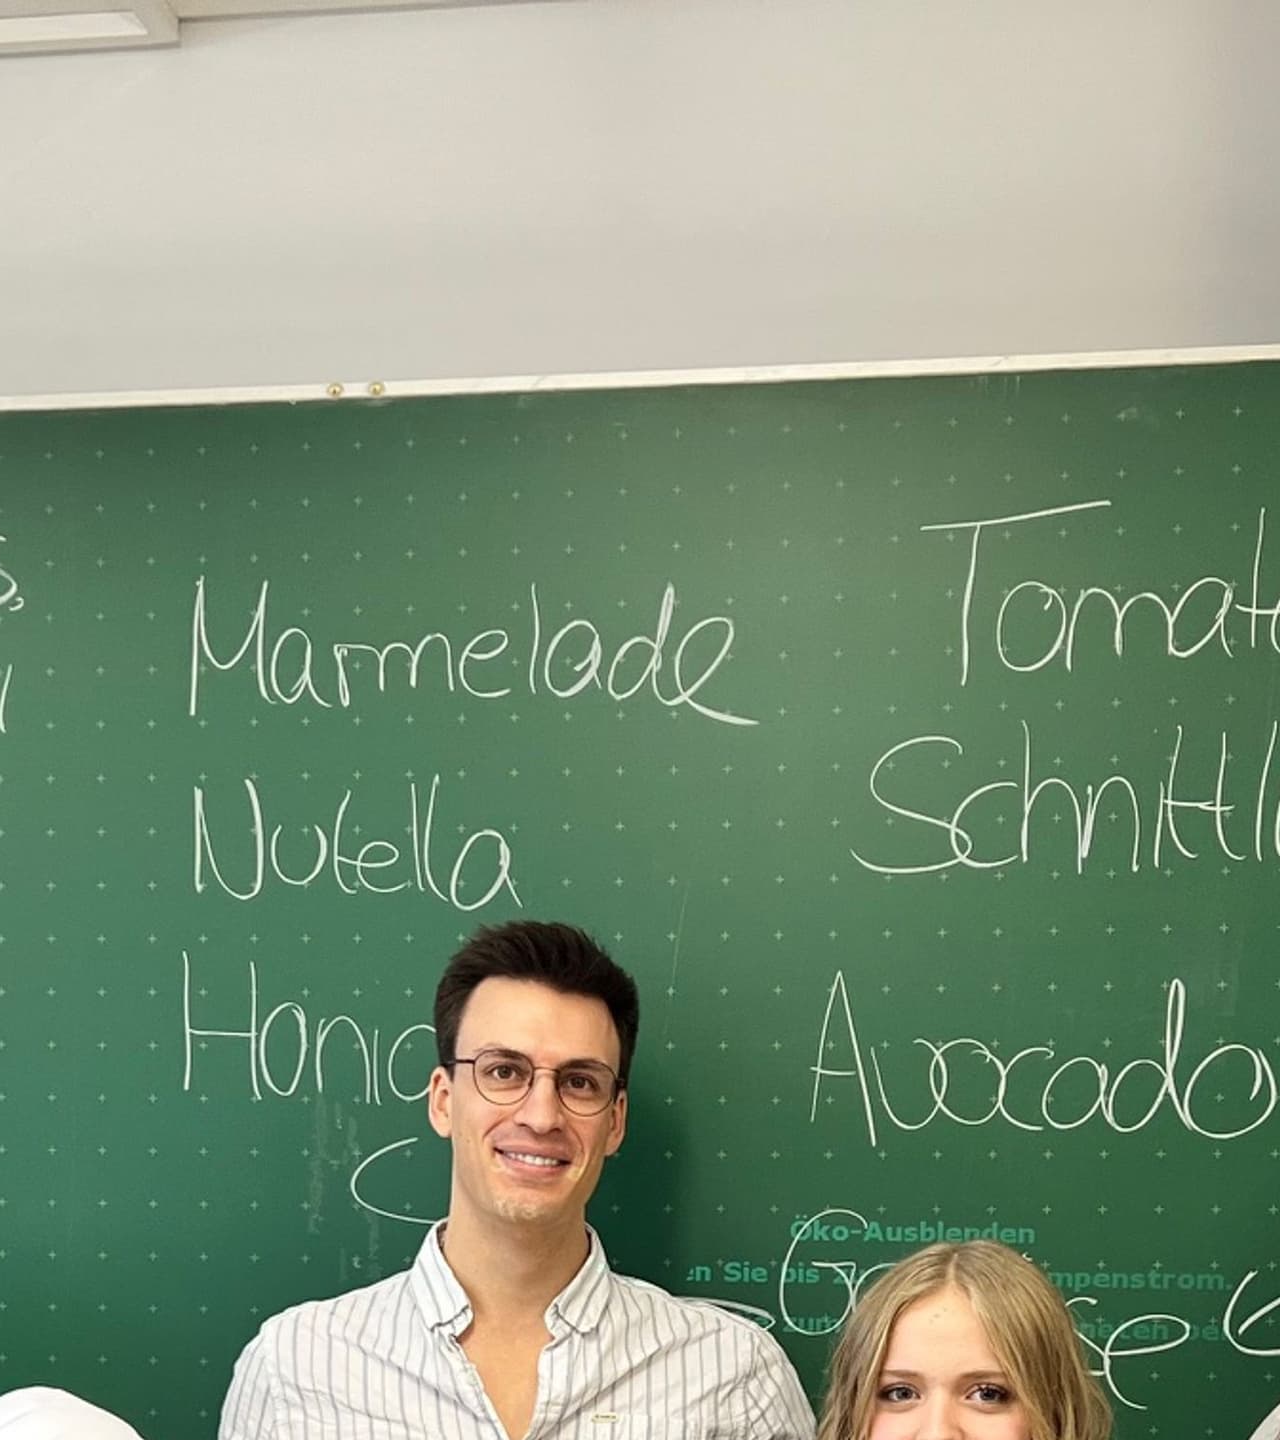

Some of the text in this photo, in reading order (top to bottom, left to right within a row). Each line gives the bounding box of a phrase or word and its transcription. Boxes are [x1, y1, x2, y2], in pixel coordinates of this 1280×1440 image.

[189, 575, 759, 725] Marmelade
[194, 773, 522, 911] Nutella
[810, 970, 1277, 1147] Avocado
[723, 1261, 768, 1284] Sie
[1049, 1268, 1236, 1293] mpenstrom.
